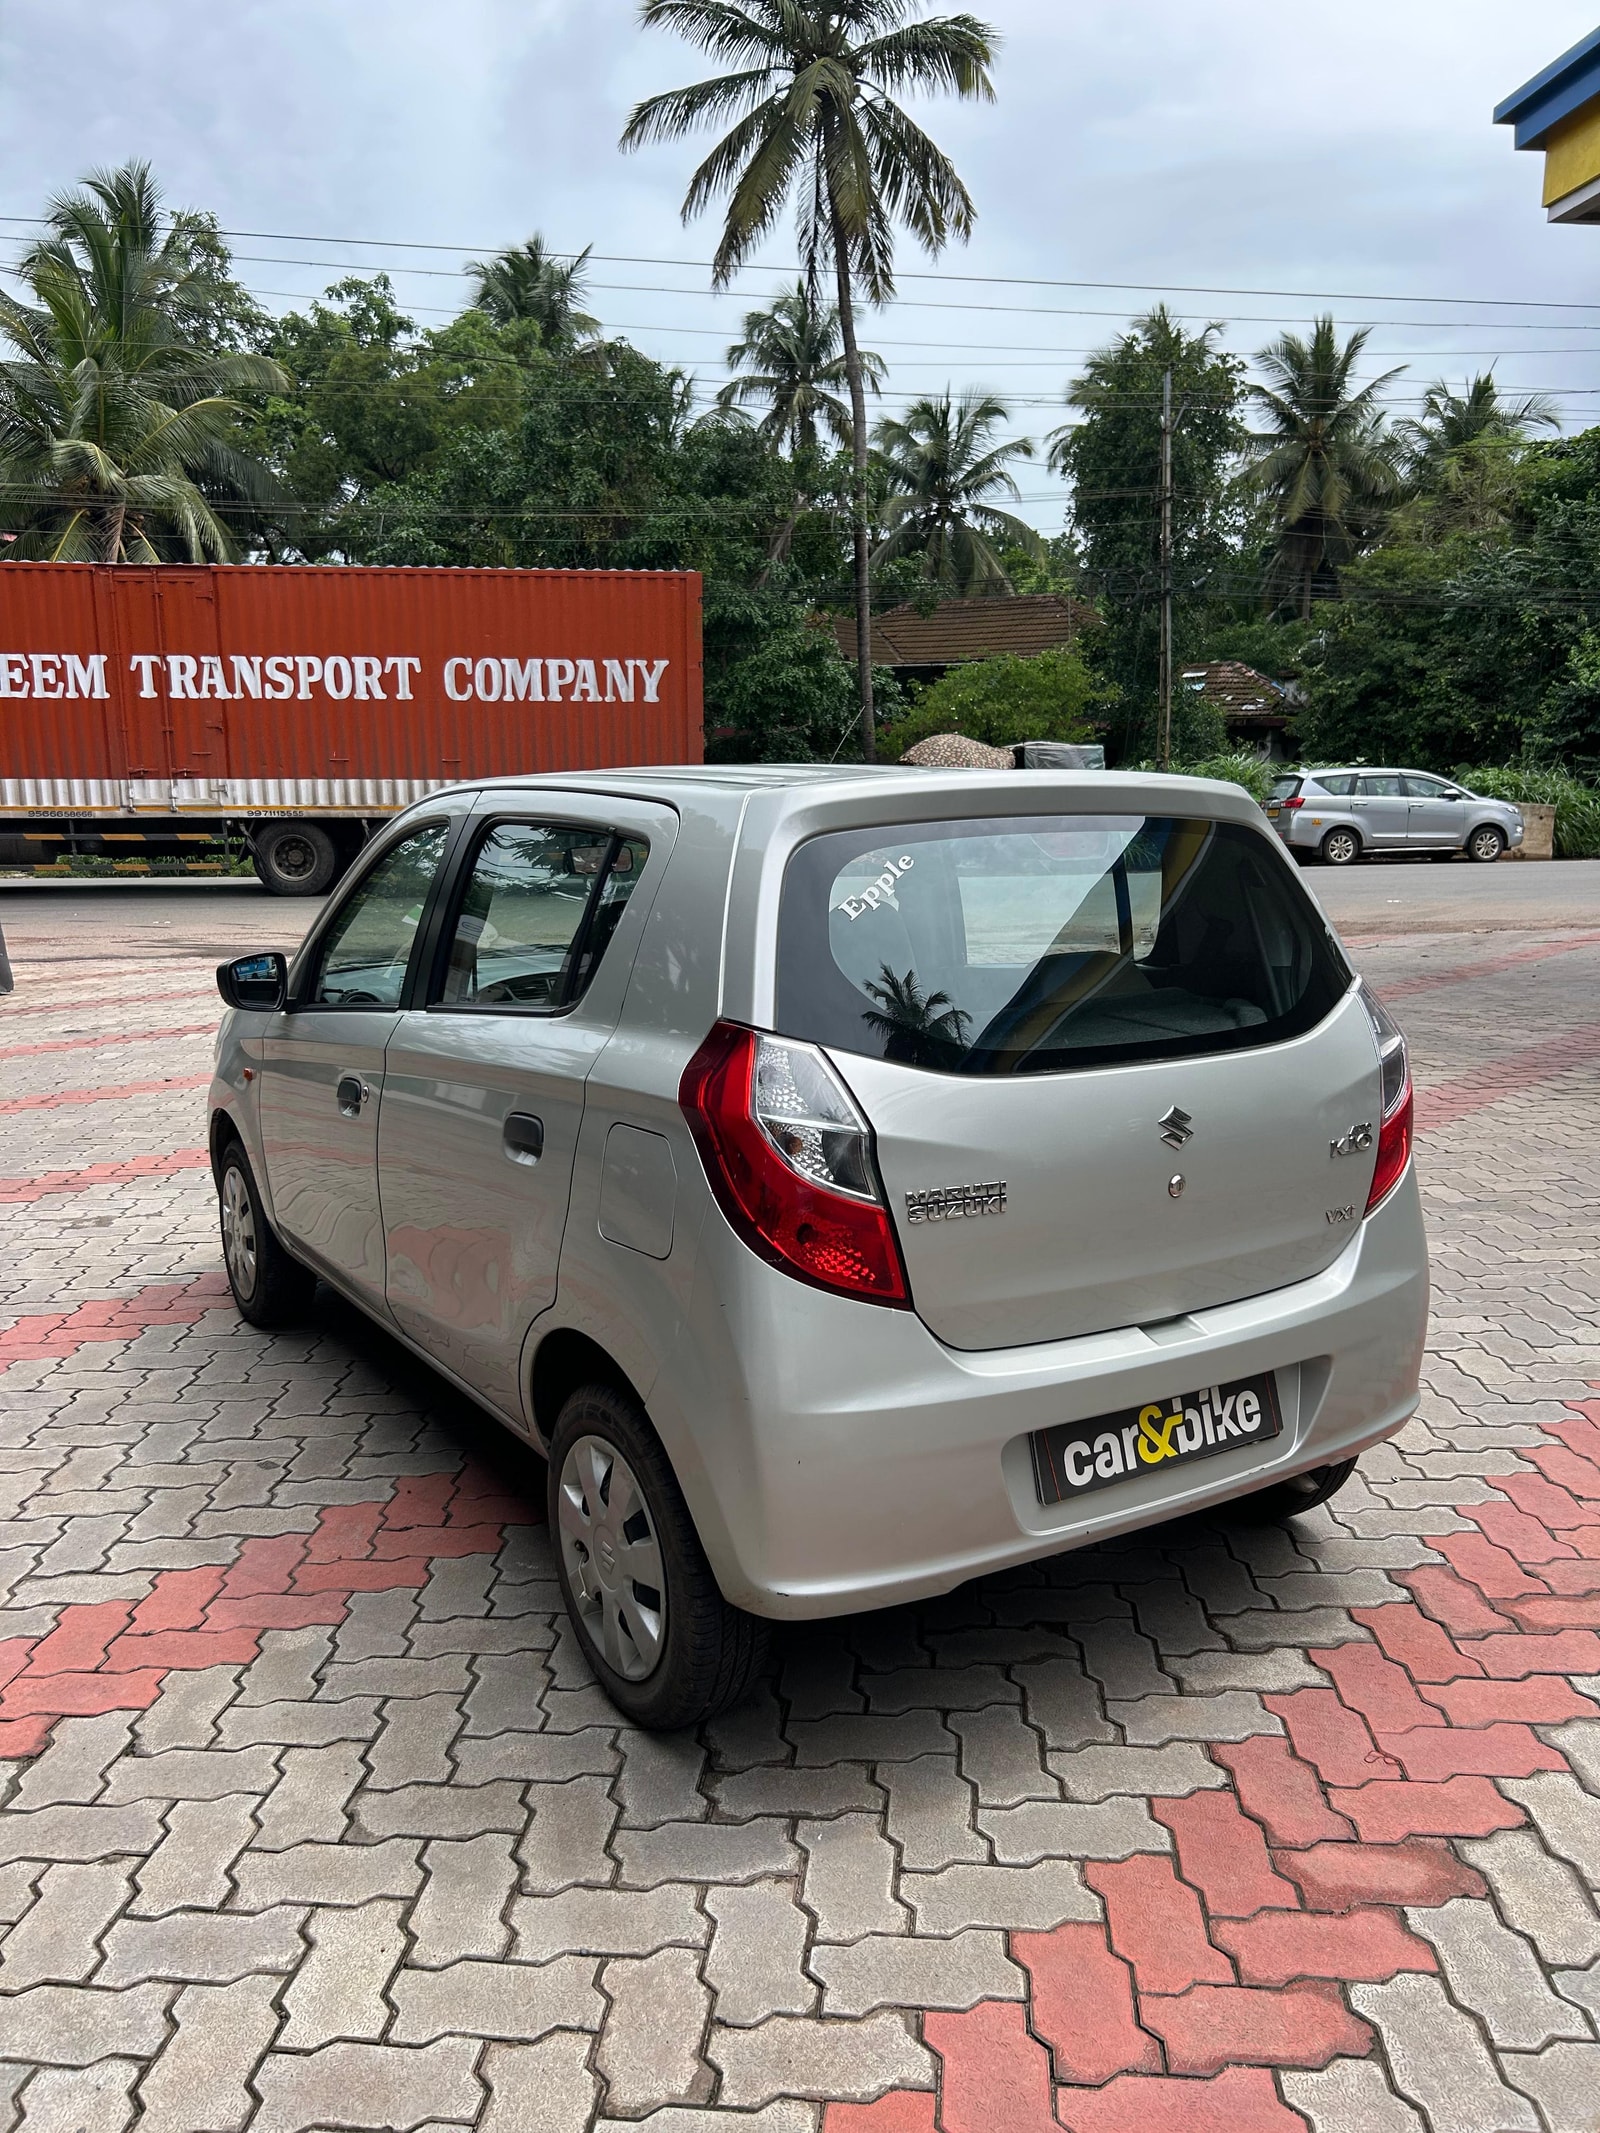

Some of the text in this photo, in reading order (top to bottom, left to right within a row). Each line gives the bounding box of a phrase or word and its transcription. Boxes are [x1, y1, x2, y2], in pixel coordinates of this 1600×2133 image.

[130, 655, 422, 700] TRANSPORT
[444, 656, 670, 702] COMPANY
[837, 855, 915, 922] Epple
[905, 1180, 1007, 1206] MARUTI
[907, 1195, 1008, 1224] SUZUKI
[1063, 1385, 1262, 1487] car&bike
